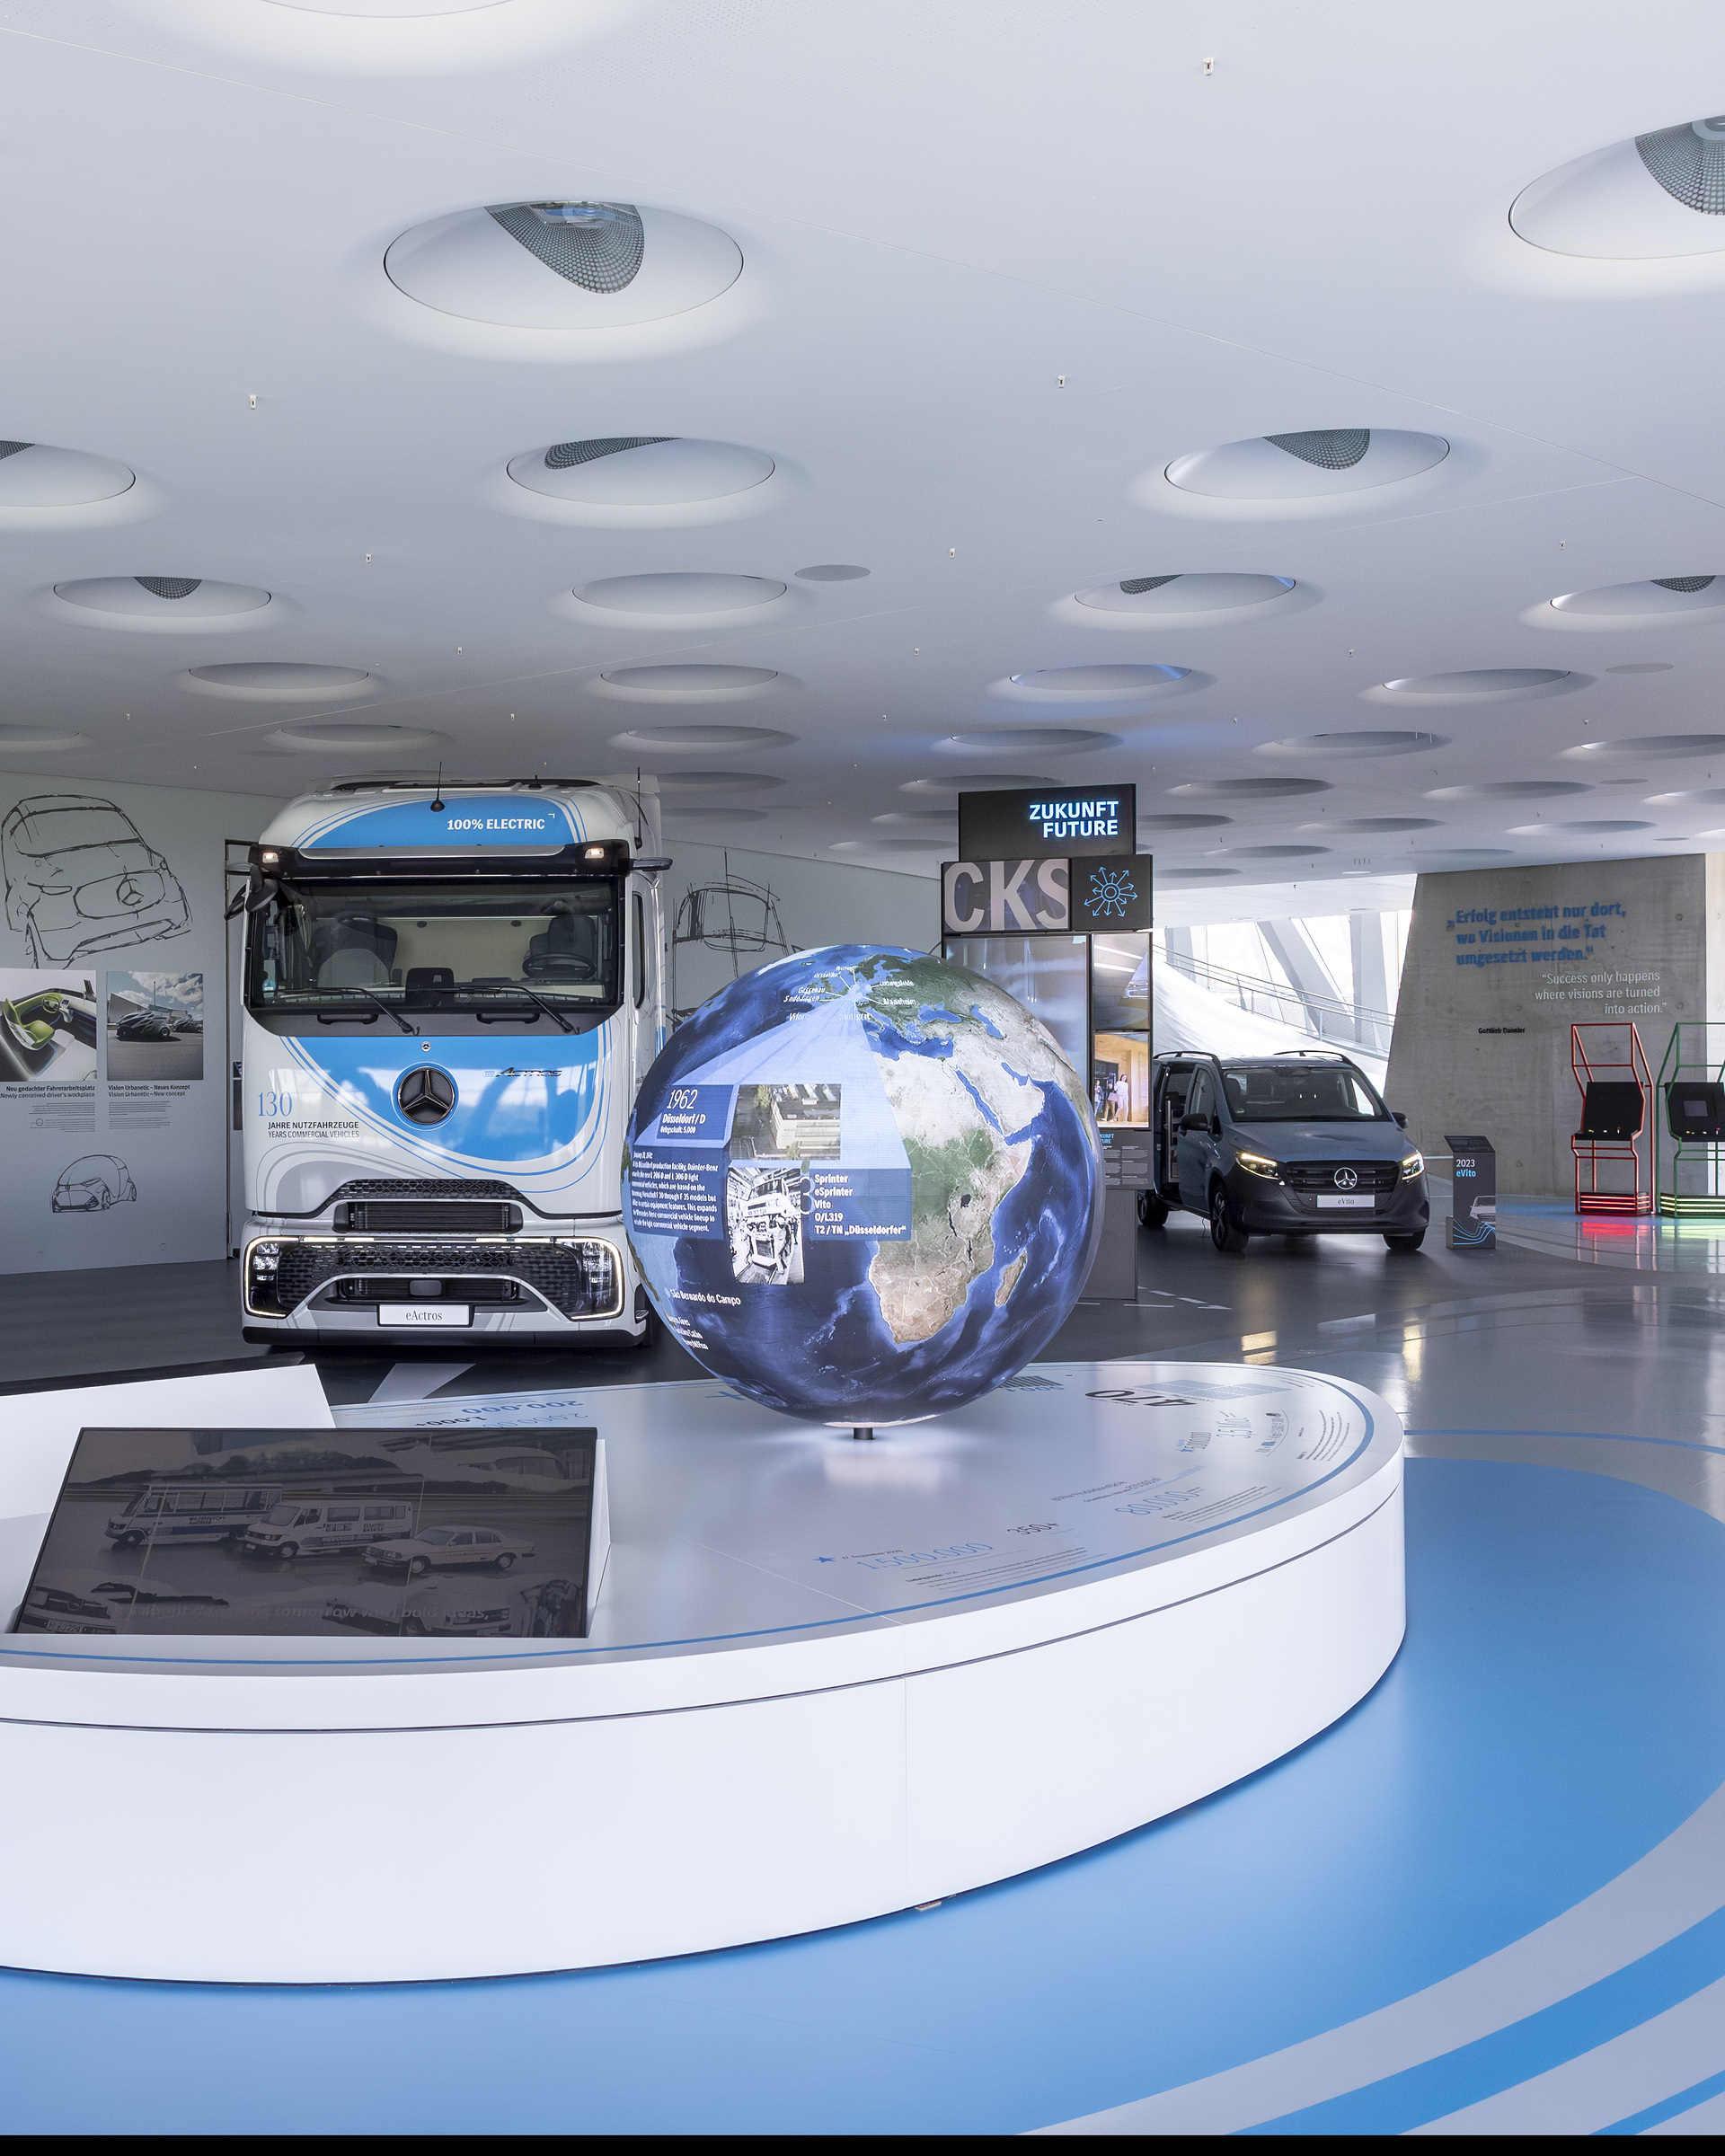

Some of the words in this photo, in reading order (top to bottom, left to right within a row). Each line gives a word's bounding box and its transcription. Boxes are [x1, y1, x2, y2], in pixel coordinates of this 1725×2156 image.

[1029, 801, 1119, 820] ZUKUNFT
[447, 819, 483, 830] 100%
[486, 819, 545, 830] ELECTRIC
[1043, 820, 1118, 838] FUTURE
[945, 858, 1069, 932] CKS
[1500, 906, 1559, 921] entsteht
[1563, 906, 1586, 918] nur
[1590, 901, 1626, 918] dort,
[1456, 932, 1476, 944] wo
[1479, 928, 1538, 943] Visionen
[1542, 926, 1554, 941] in
[1558, 925, 1580, 940] die
[1583, 924, 1606, 939] Tat
[1456, 949, 1527, 967] umgesetzt
[1591, 972, 1613, 985] only
[1616, 971, 1660, 984] happens
[1535, 989, 1565, 1000] where
[1568, 987, 1604, 999] visions
[1606, 989, 1623, 998] are
[1625, 986, 1660, 998] turned
[1605, 1003, 1625, 1014] into
[258, 1091, 292, 1117] 130
[666, 1089, 698, 1109] 1962
[662, 1114, 695, 1124] Düsseldorf
[687, 1163, 718, 1172] Daimler-Benz
[1456, 1159, 1475, 1167] 2023
[689, 1173, 699, 1182] light
[814, 1174, 848, 1185] Sprinter
[814, 1187, 853, 1197] eSprinter
[814, 1200, 831, 1209] Vito
[814, 1213, 844, 1222] O/L319
[689, 1224, 709, 1232] segment.
[814, 1225, 825, 1234] T2
[832, 1225, 843, 1234] TN
[680, 1290, 706, 1302] Bernardo
[707, 1293, 716, 1303] do
[716, 1294, 741, 1306] Campo
[406, 1310, 442, 1320] eActros
[1085, 1390, 1197, 1406] 470
[461, 1400, 584, 1414] 200.000
[1115, 1491, 1200, 1515] 80.000
[856, 1542, 993, 1570] 1.500.000
